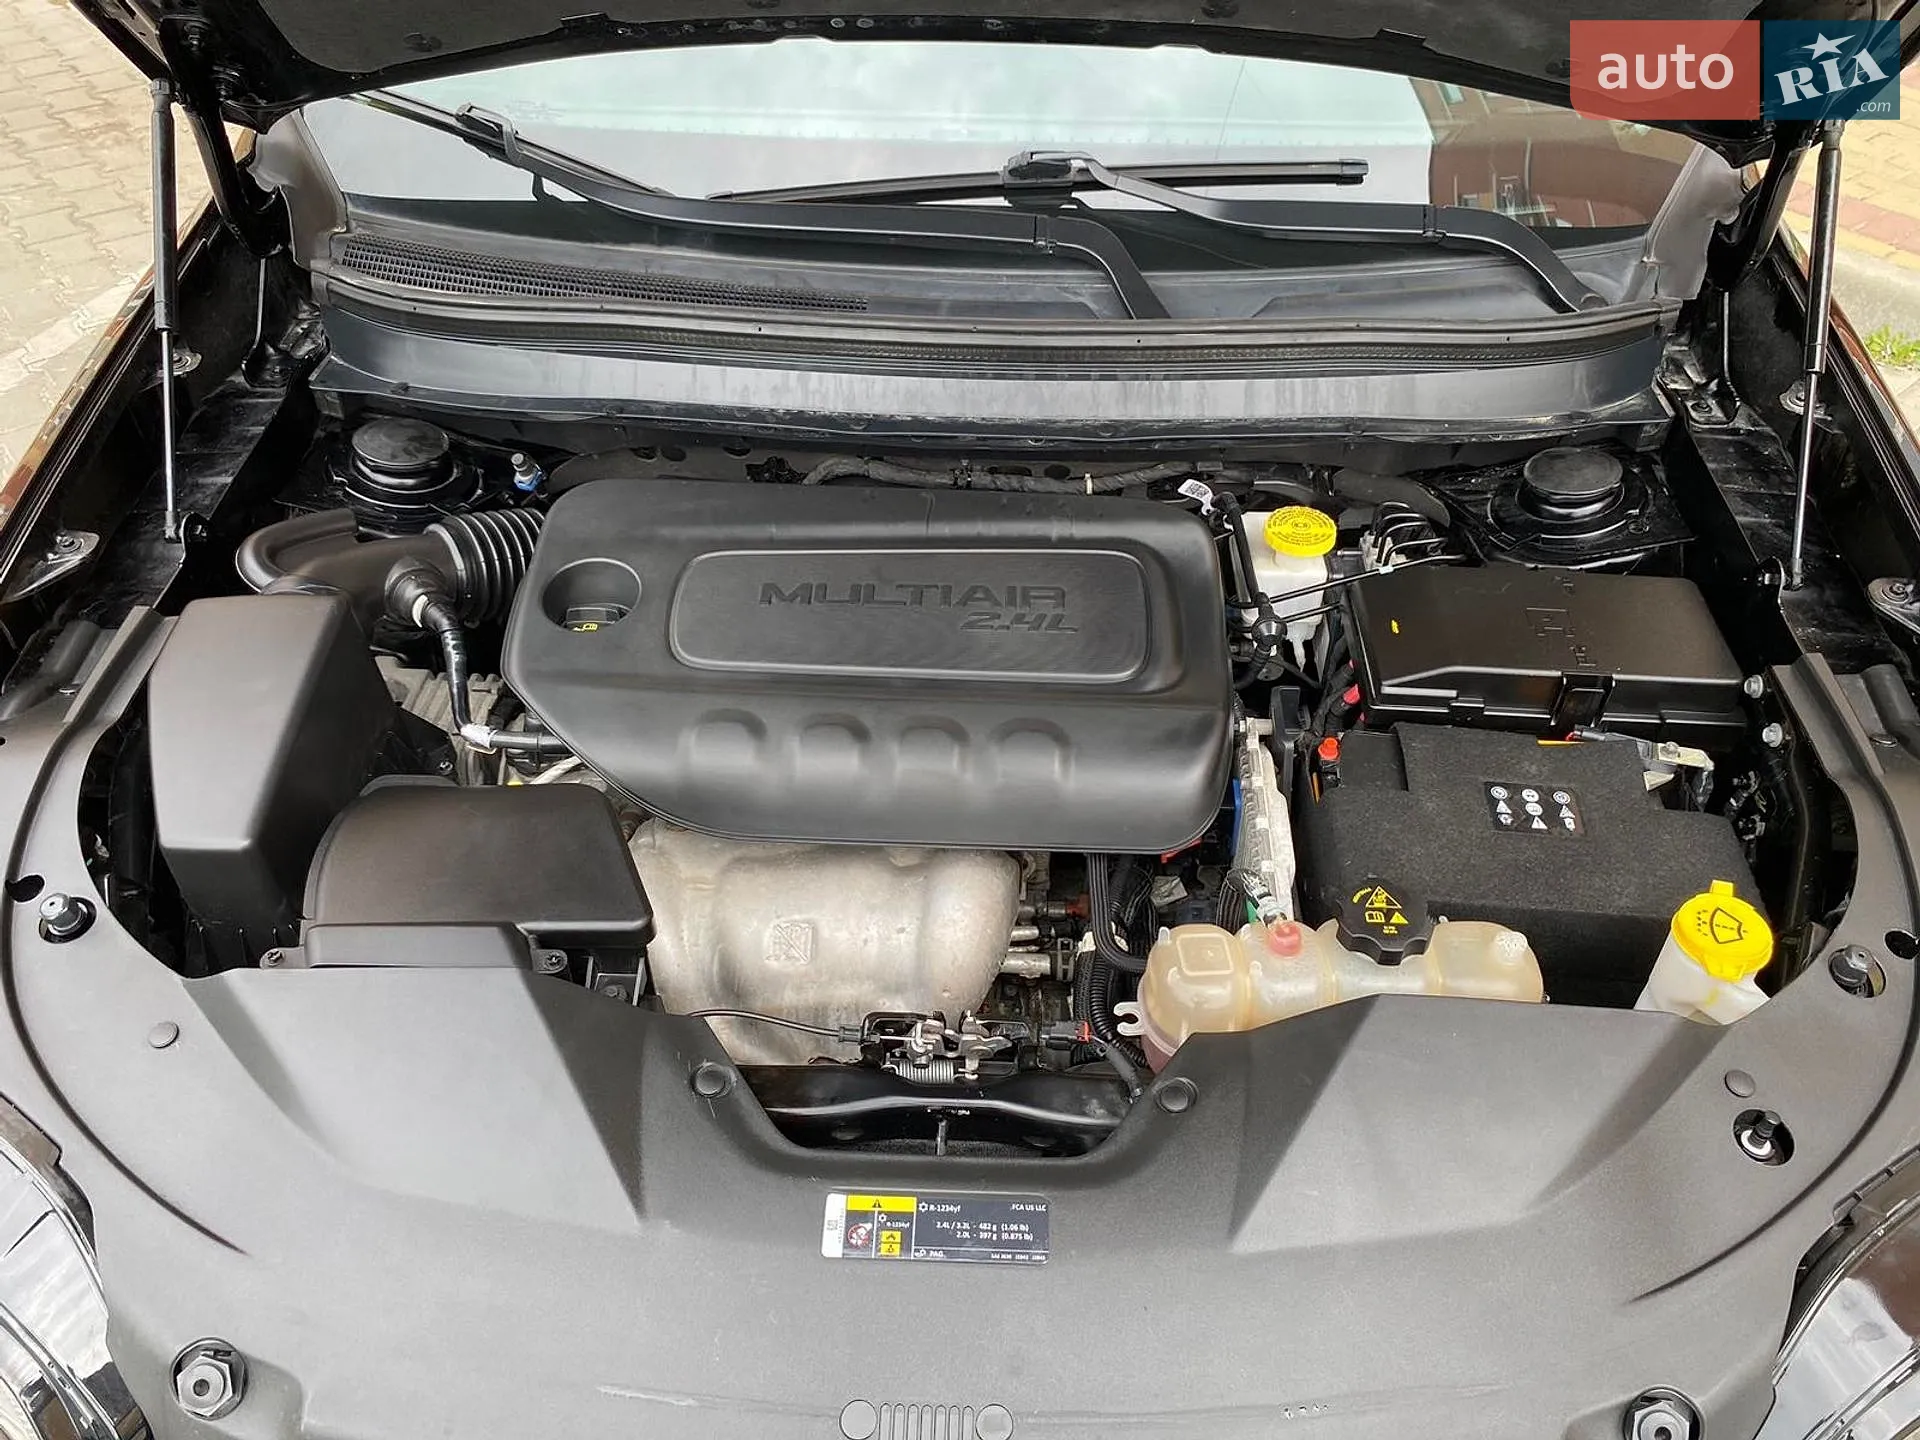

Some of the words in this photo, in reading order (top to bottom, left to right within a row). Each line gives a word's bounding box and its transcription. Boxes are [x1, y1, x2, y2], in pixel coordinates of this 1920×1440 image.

[758, 582, 1067, 609] MULTIAIR
[959, 611, 1079, 633] 2.4L
[929, 1203, 961, 1214] R-1234yf
[1012, 1203, 1025, 1211] FCA
[1035, 1204, 1047, 1212] LLC
[956, 1231, 971, 1239] 2.0L
